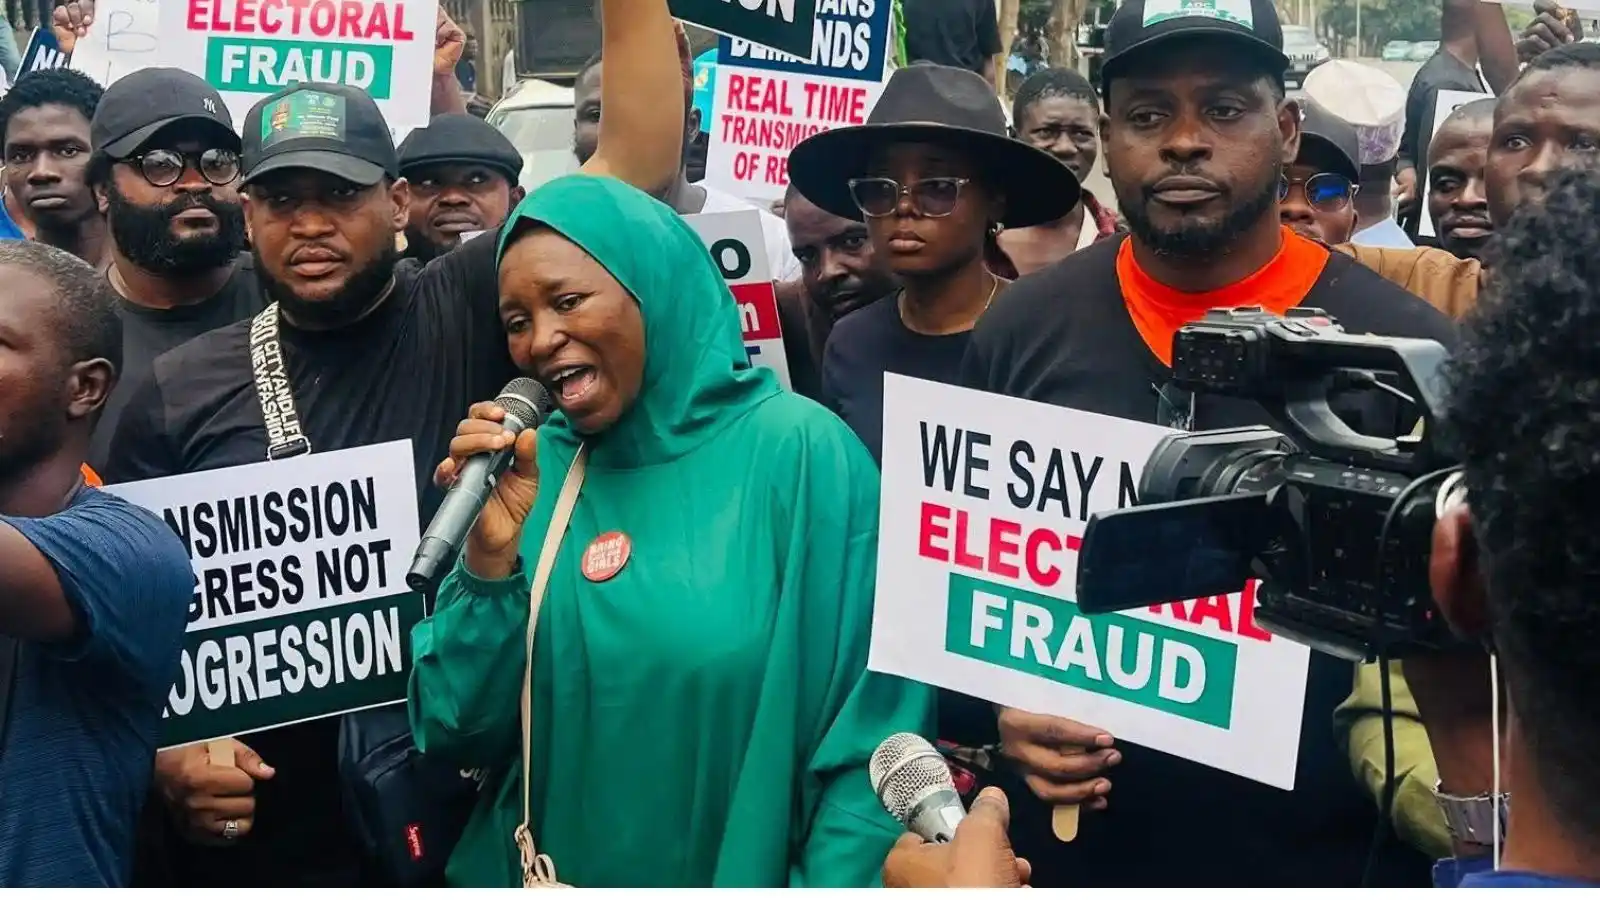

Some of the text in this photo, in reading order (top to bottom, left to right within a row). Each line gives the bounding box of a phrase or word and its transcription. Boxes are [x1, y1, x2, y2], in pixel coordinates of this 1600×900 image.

[107, 11, 157, 52] B
[187, 0, 414, 40] ELECTORAL
[221, 45, 376, 88] FRAUD
[727, 74, 867, 124] REAL TIME
[733, 152, 760, 180] OF
[919, 421, 991, 500] WE
[1007, 440, 1103, 521] SAY
[316, 539, 392, 598] NOT
[162, 607, 402, 718] OGRESSION
[969, 590, 1207, 704] FRAUD
